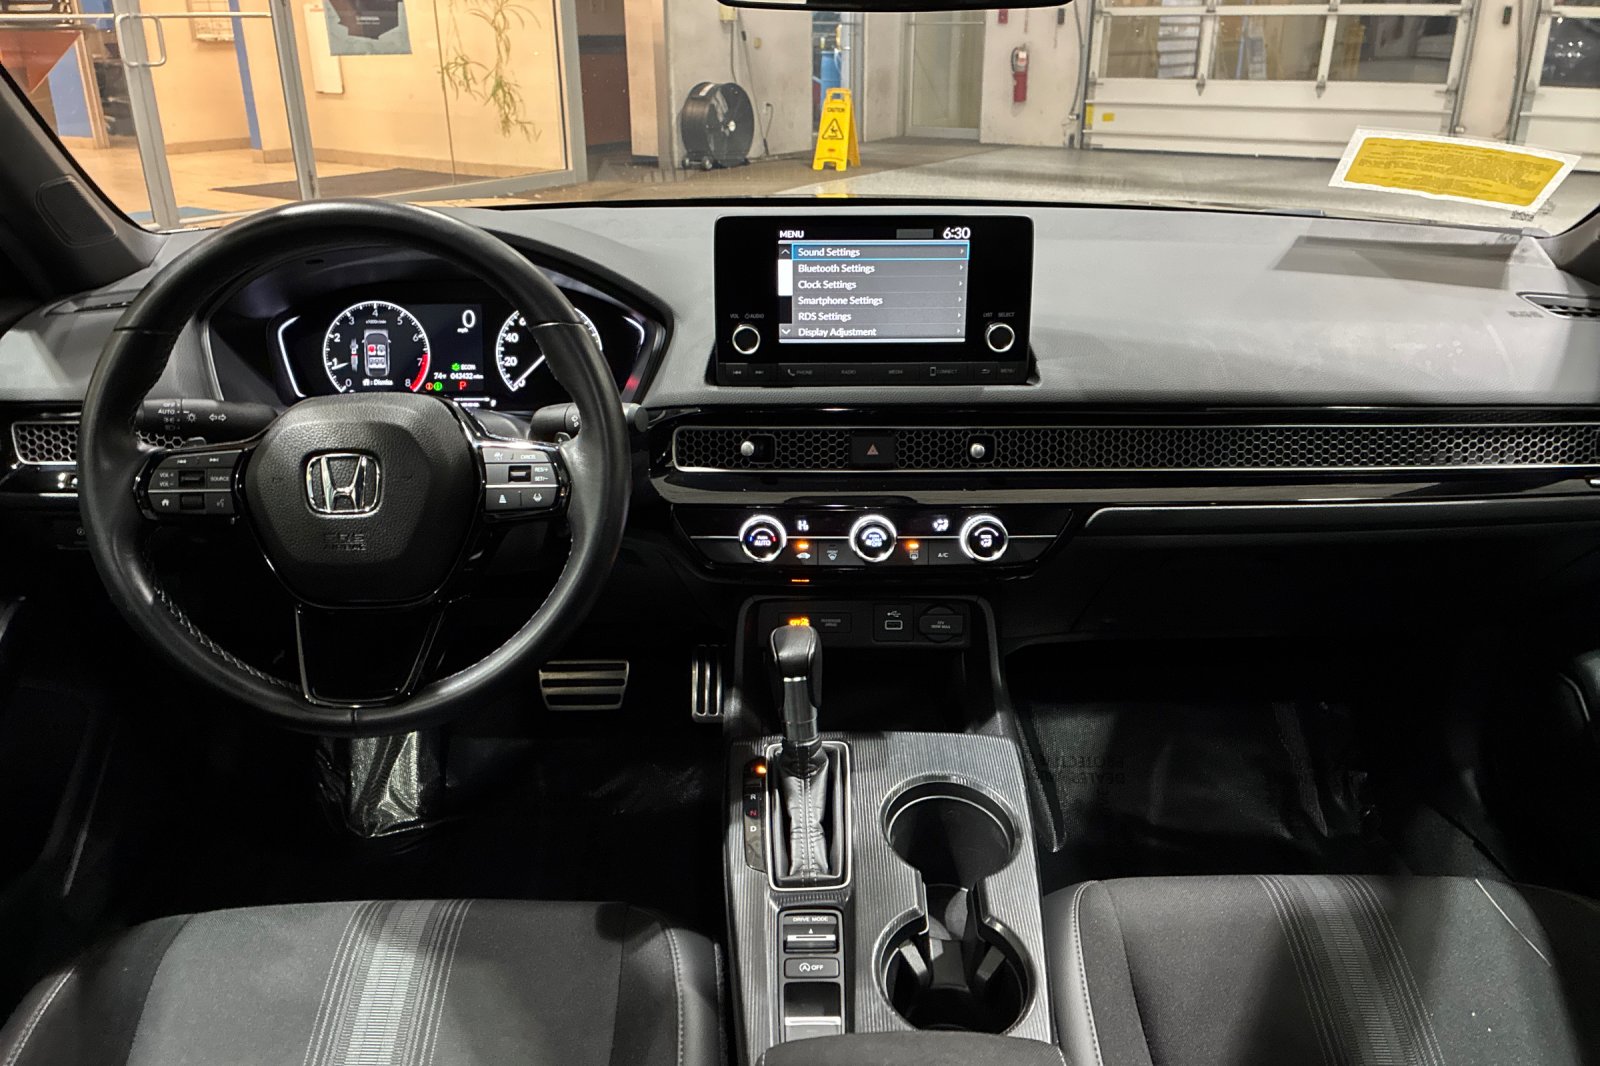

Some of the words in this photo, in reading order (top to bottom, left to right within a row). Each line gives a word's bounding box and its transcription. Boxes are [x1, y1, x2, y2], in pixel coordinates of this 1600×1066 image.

[780, 230, 804, 238] MENU
[942, 227, 971, 239] 6:30
[798, 248, 824, 257] Sound
[826, 248, 860, 258] Settings
[798, 264, 840, 274] Bluetooth
[841, 264, 875, 275] Settings
[798, 280, 821, 290] Clock
[823, 280, 856, 291] Settings
[798, 296, 848, 308] Smartphone
[850, 296, 883, 307] Settings
[348, 317, 354, 325] 3
[397, 317, 403, 325] 5
[462, 310, 476, 328] 0
[798, 312, 816, 321] RDS
[818, 312, 852, 322] Settings
[505, 333, 518, 342] 40
[798, 328, 827, 338] Display
[830, 328, 876, 338] Adjustment
[334, 334, 340, 342] 2
[413, 334, 418, 342] 6
[416, 358, 422, 366] 7
[504, 357, 518, 366] 20
[345, 378, 352, 387] 0
[405, 379, 411, 387] 8
[460, 381, 466, 390] P
